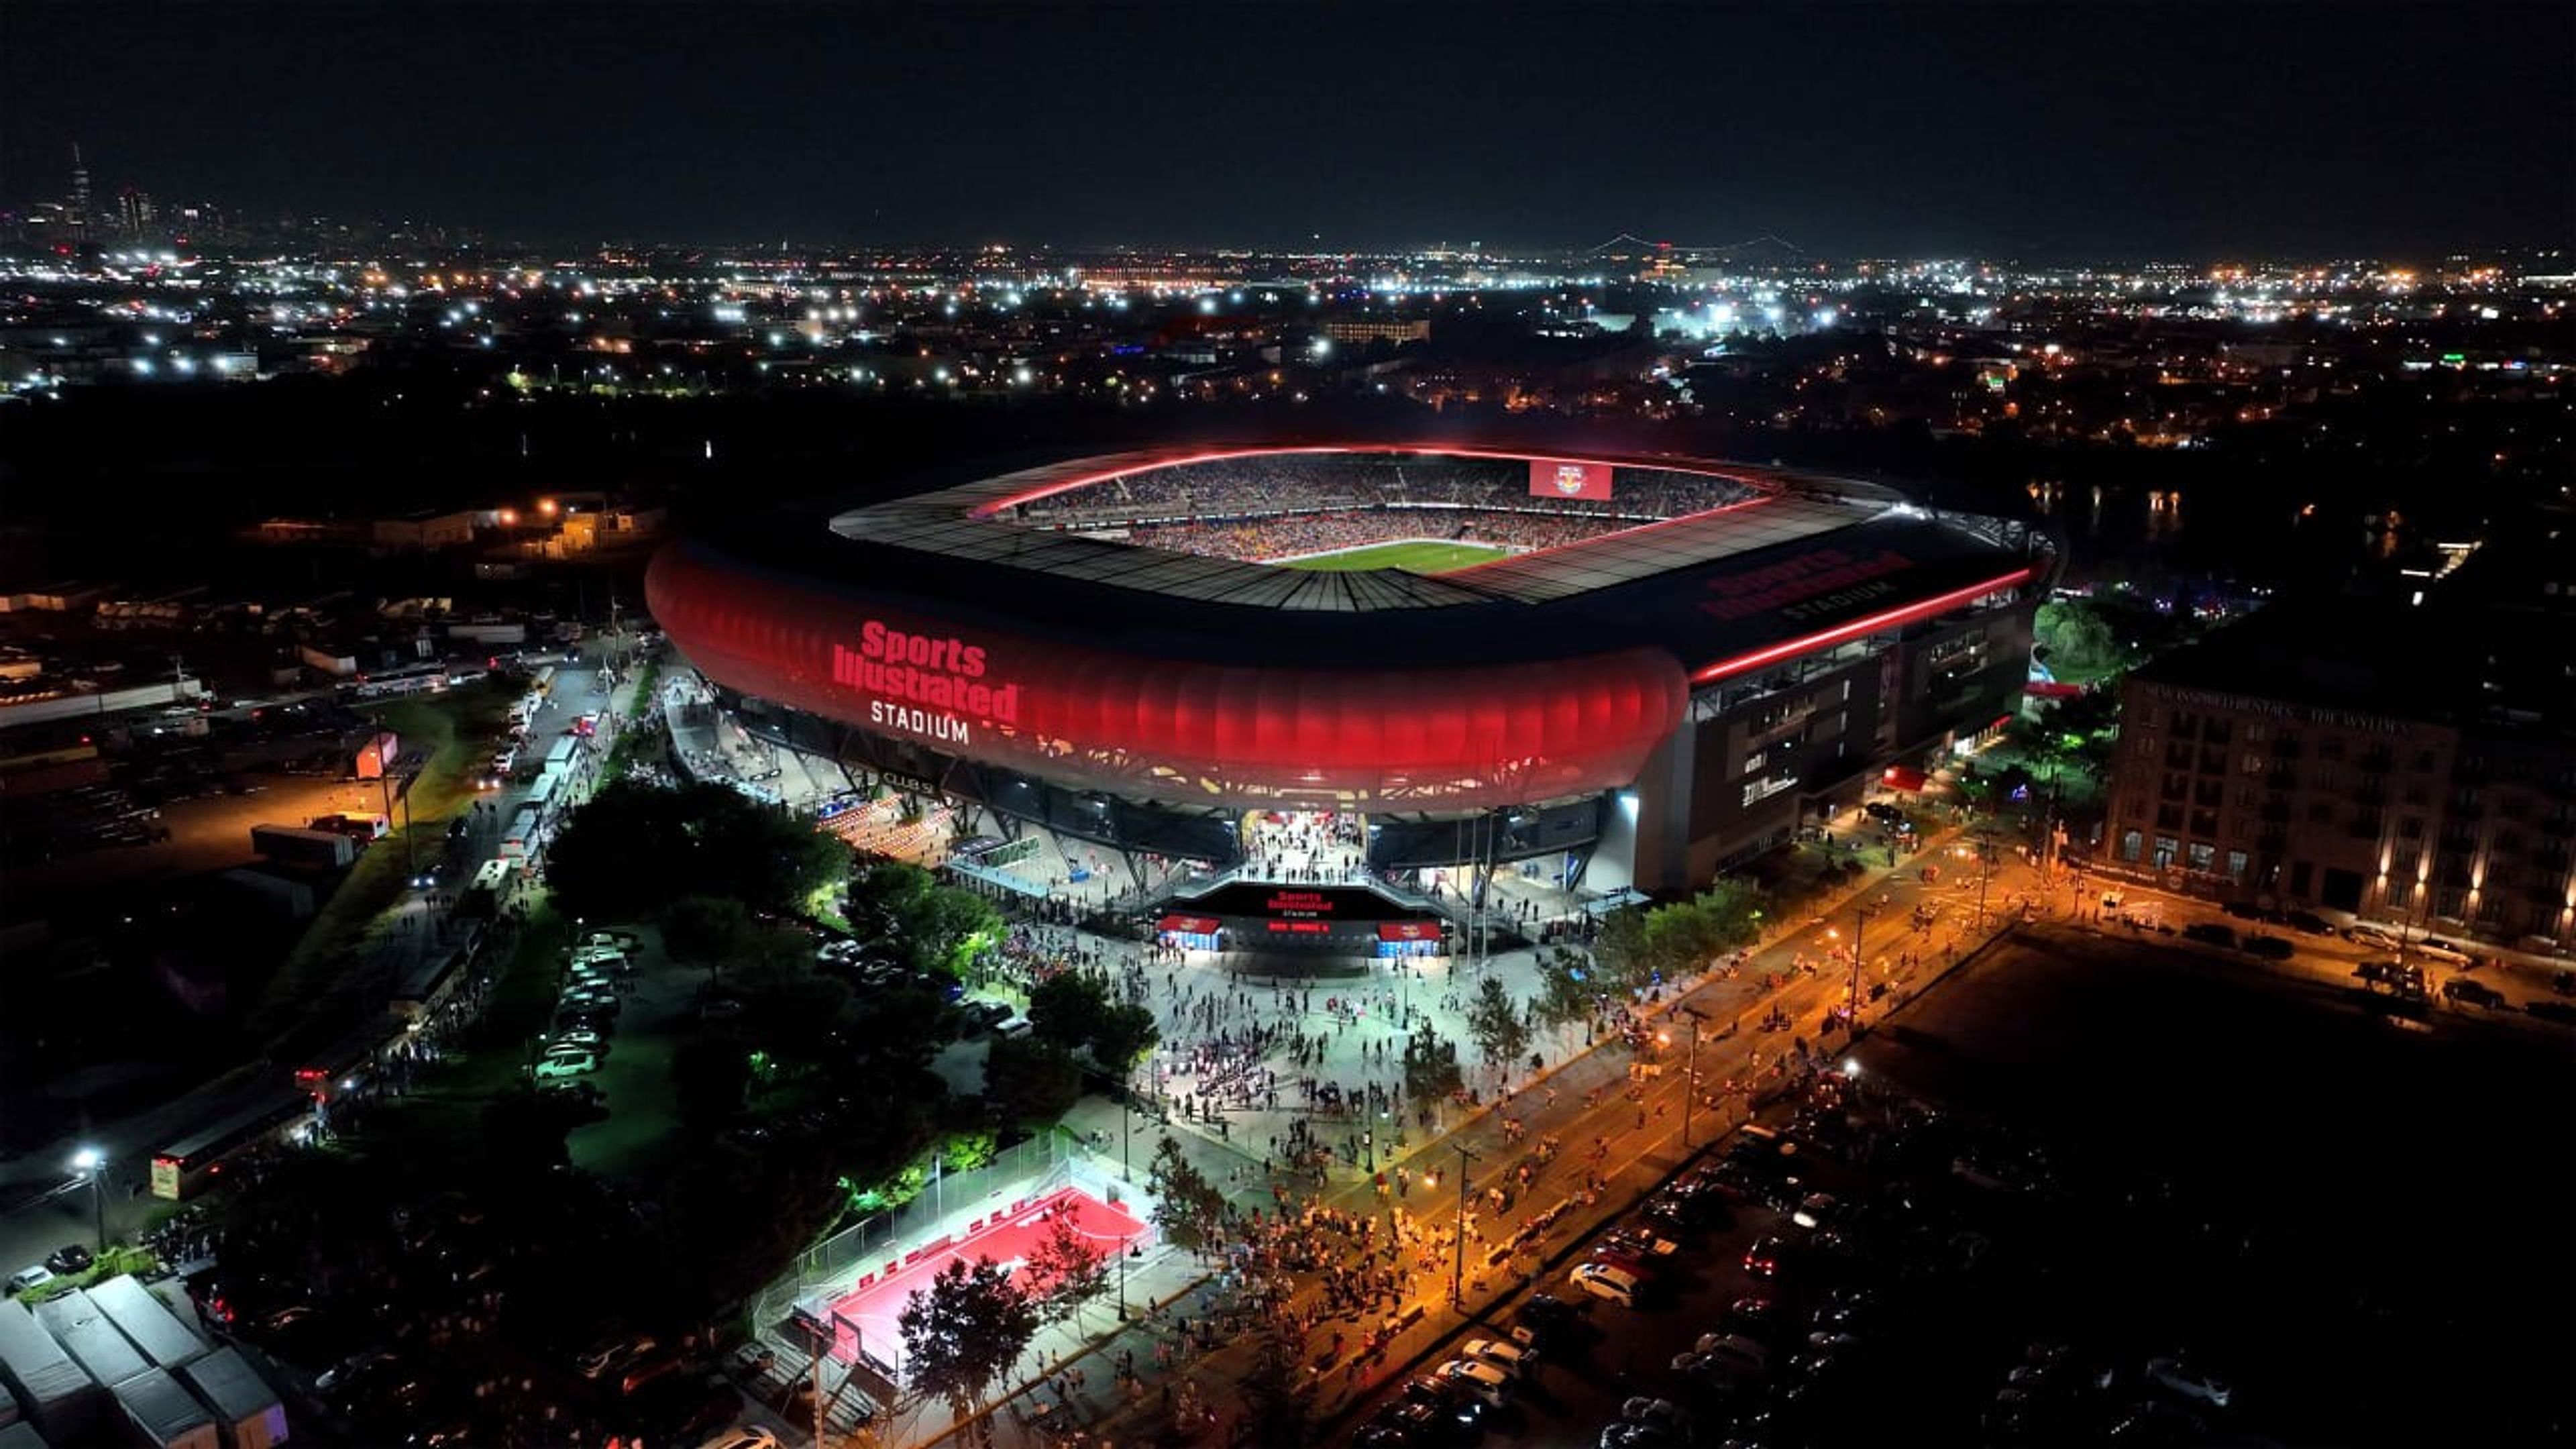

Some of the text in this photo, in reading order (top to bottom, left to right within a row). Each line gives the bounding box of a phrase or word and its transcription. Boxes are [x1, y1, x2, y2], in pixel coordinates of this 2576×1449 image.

[862, 620, 986, 677] Sports
[834, 644, 1018, 722] Illustrated
[871, 700, 969, 744] STADIUM
